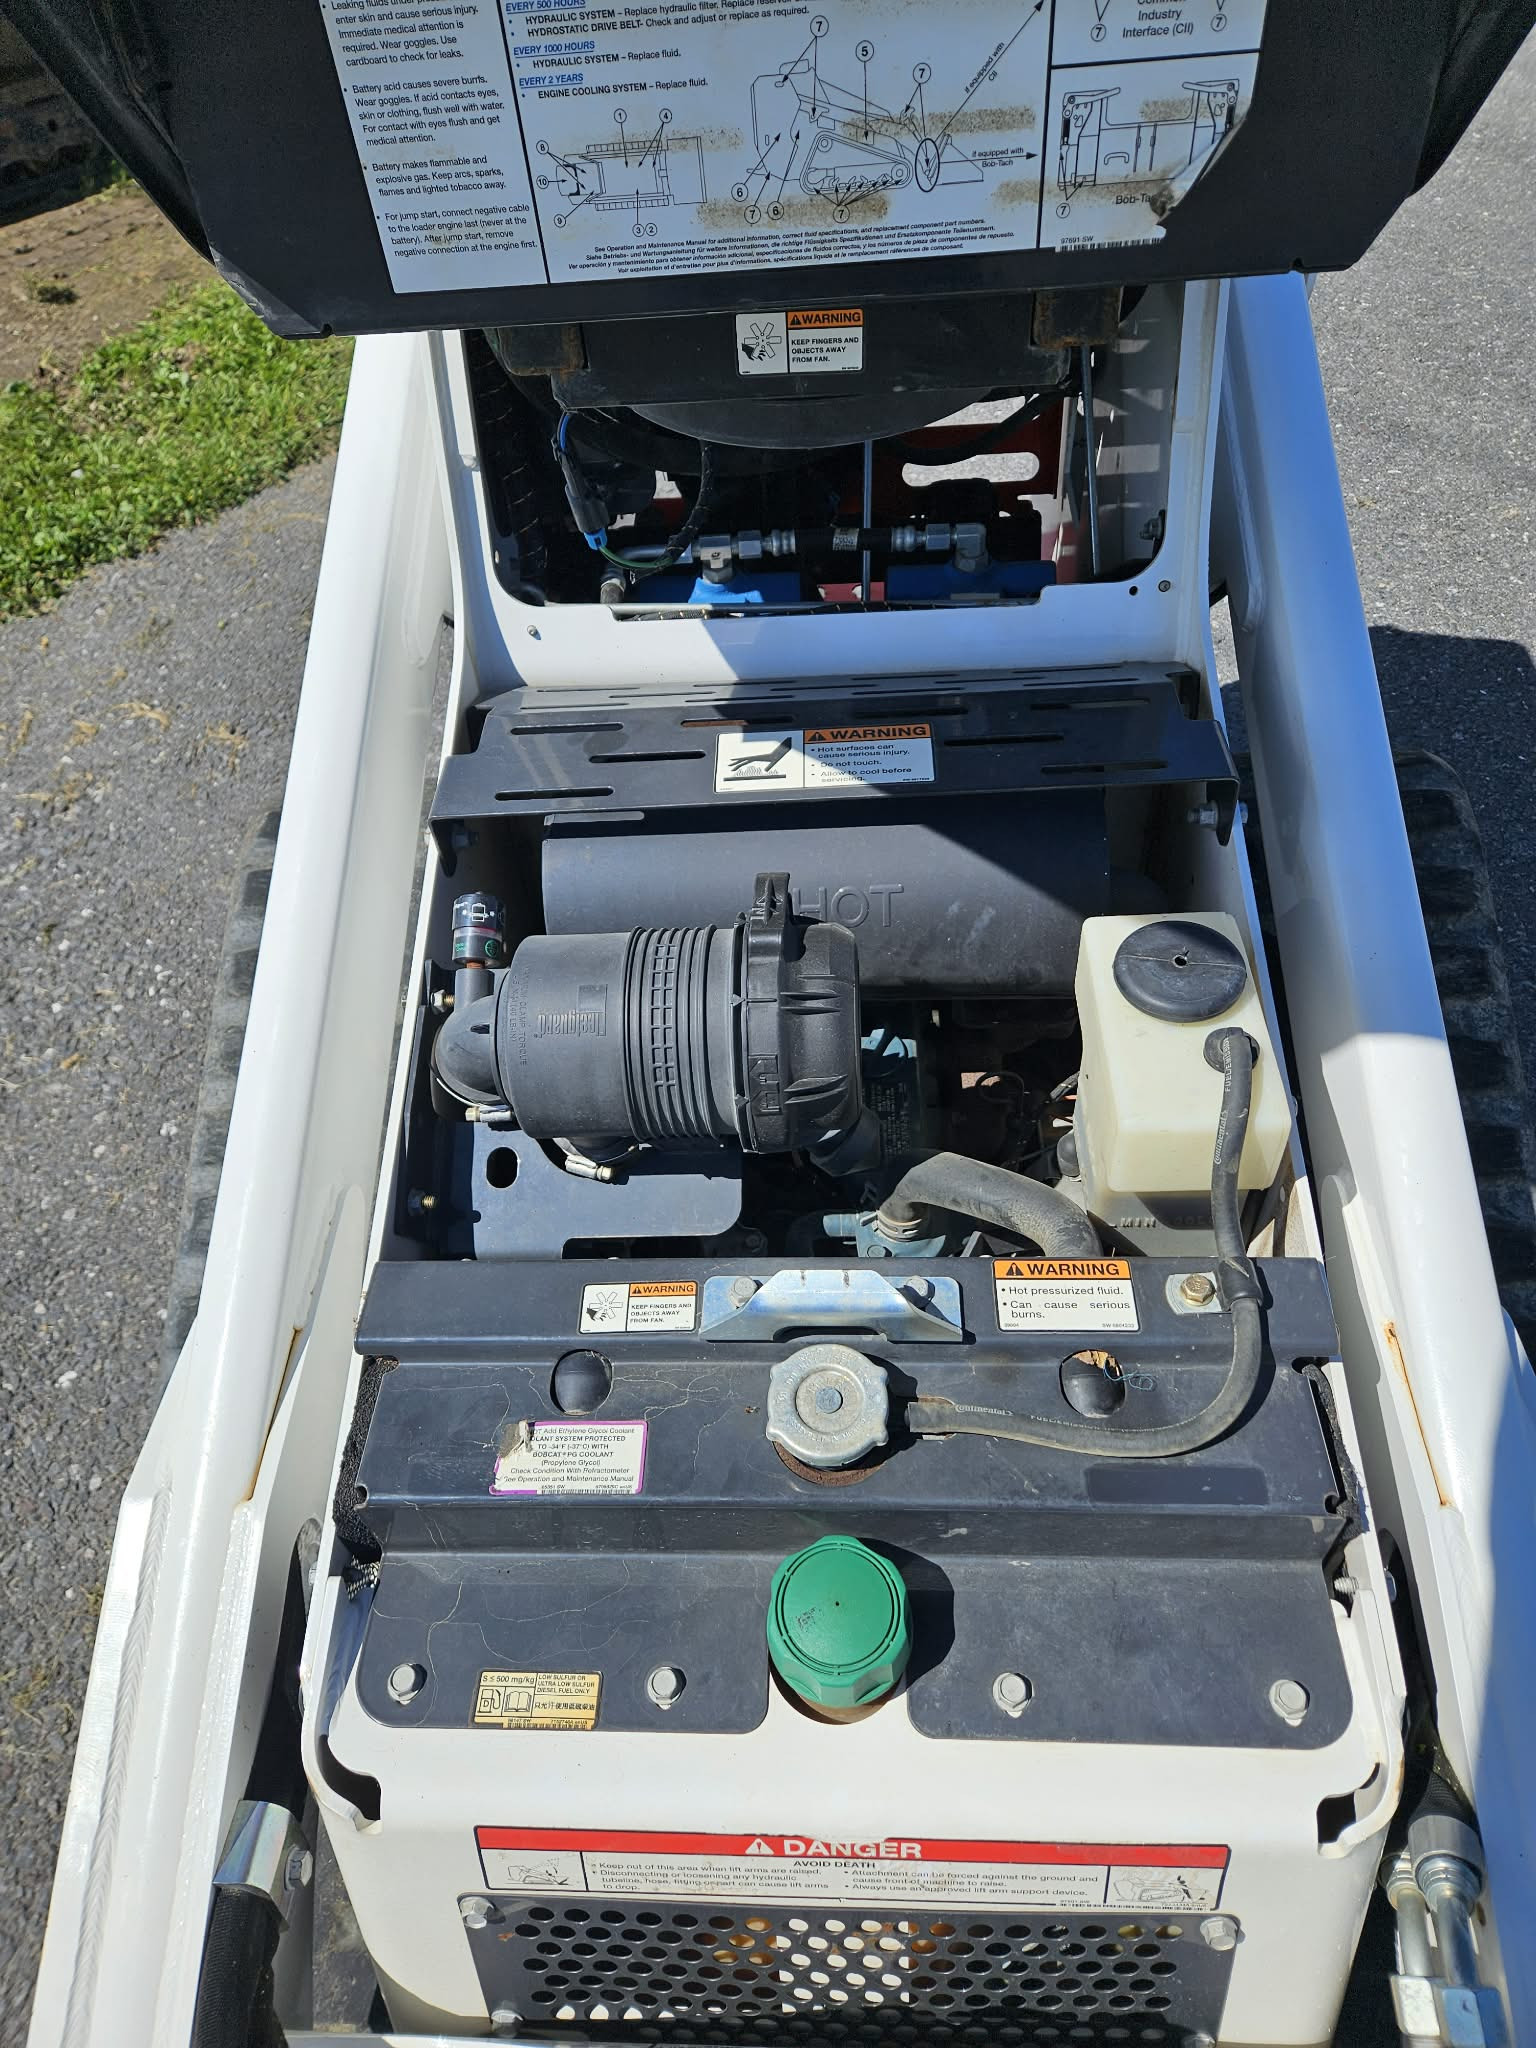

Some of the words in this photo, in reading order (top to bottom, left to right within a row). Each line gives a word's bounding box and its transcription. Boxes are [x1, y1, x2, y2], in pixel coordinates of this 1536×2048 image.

[506, 2, 534, 11] EVERY
[537, 0, 551, 9] 500
[554, 0, 585, 8] HOURS
[336, 15, 356, 24] enter
[359, 13, 375, 22] skin
[378, 11, 393, 20] and
[396, 11, 420, 19] cause
[423, 6, 452, 17] serious
[454, 4, 478, 16] injury.
[525, 12, 577, 24] HYDRAULIC
[579, 9, 615, 20] SYSTEM
[625, 6, 657, 18] Replace
[659, 3, 696, 16] hydraulic
[700, 0, 718, 9] filter.
[721, 0, 755, 10] Replace
[1138, 10, 1181, 21] Industry
[528, 25, 589, 37] HYDROSTATIC
[591, 22, 617, 32] DRIVE
[646, 18, 672, 28] Check
[674, 17, 688, 25] and
[692, 14, 716, 25] adjust
[729, 10, 759, 22] replace
[773, 6, 809, 18] required.
[816, 22, 822, 32] 7
[338, 27, 381, 38] Immediate
[384, 24, 416, 34] medical
[419, 21, 454, 32] attention
[457, 20, 463, 28] is
[1095, 28, 1102, 38] 7
[1123, 25, 1169, 38] Interface
[1173, 22, 1193, 35] (CII)
[514, 46, 541, 55] EVERY
[544, 44, 562, 53] 1000
[564, 41, 595, 51] HOURS
[533, 57, 582, 68] HYDRAULIC
[585, 54, 619, 64] SYSTEM
[628, 50, 660, 63] Replace
[662, 49, 681, 58] fluid.
[918, 69, 925, 78] 7
[519, 77, 546, 86] EVERY
[548, 76, 553, 84] 2
[556, 74, 583, 83] YEARS
[538, 89, 570, 98] ENGINE
[572, 86, 610, 96] COOLING
[613, 83, 646, 93] SYSTEM
[655, 80, 687, 92] Replace
[359, 111, 375, 120] skin
[387, 107, 421, 120] clothing,
[423, 105, 442, 115] flush
[444, 104, 459, 113] well
[462, 103, 478, 112] with
[480, 101, 504, 110] water.
[662, 111, 669, 121] 4
[978, 148, 1008, 157] equipped
[982, 159, 1013, 167] Bob-Tach
[538, 177, 548, 187] 10
[773, 206, 779, 215] 6
[1061, 206, 1066, 215] 7
[557, 216, 563, 226] 9
[395, 247, 425, 258] negative
[428, 244, 469, 254] connection
[480, 243, 491, 251] the
[494, 241, 519, 252] engine
[521, 240, 538, 248] first.
[802, 312, 860, 324] WARNING
[830, 727, 927, 739] WARNING
[792, 884, 904, 928] HOT
[1027, 1263, 1120, 1275] WARNING
[644, 1285, 694, 1293] WARNING
[1009, 1287, 1029, 1295] Hot
[1031, 1287, 1094, 1296] pressurized
[1098, 1287, 1123, 1295] fluid.
[1012, 1310, 1045, 1318] burns.
[511, 1676, 535, 1685] mg/kg
[783, 1839, 922, 1858] DANGER
[834, 1861, 876, 1869] DEATH
